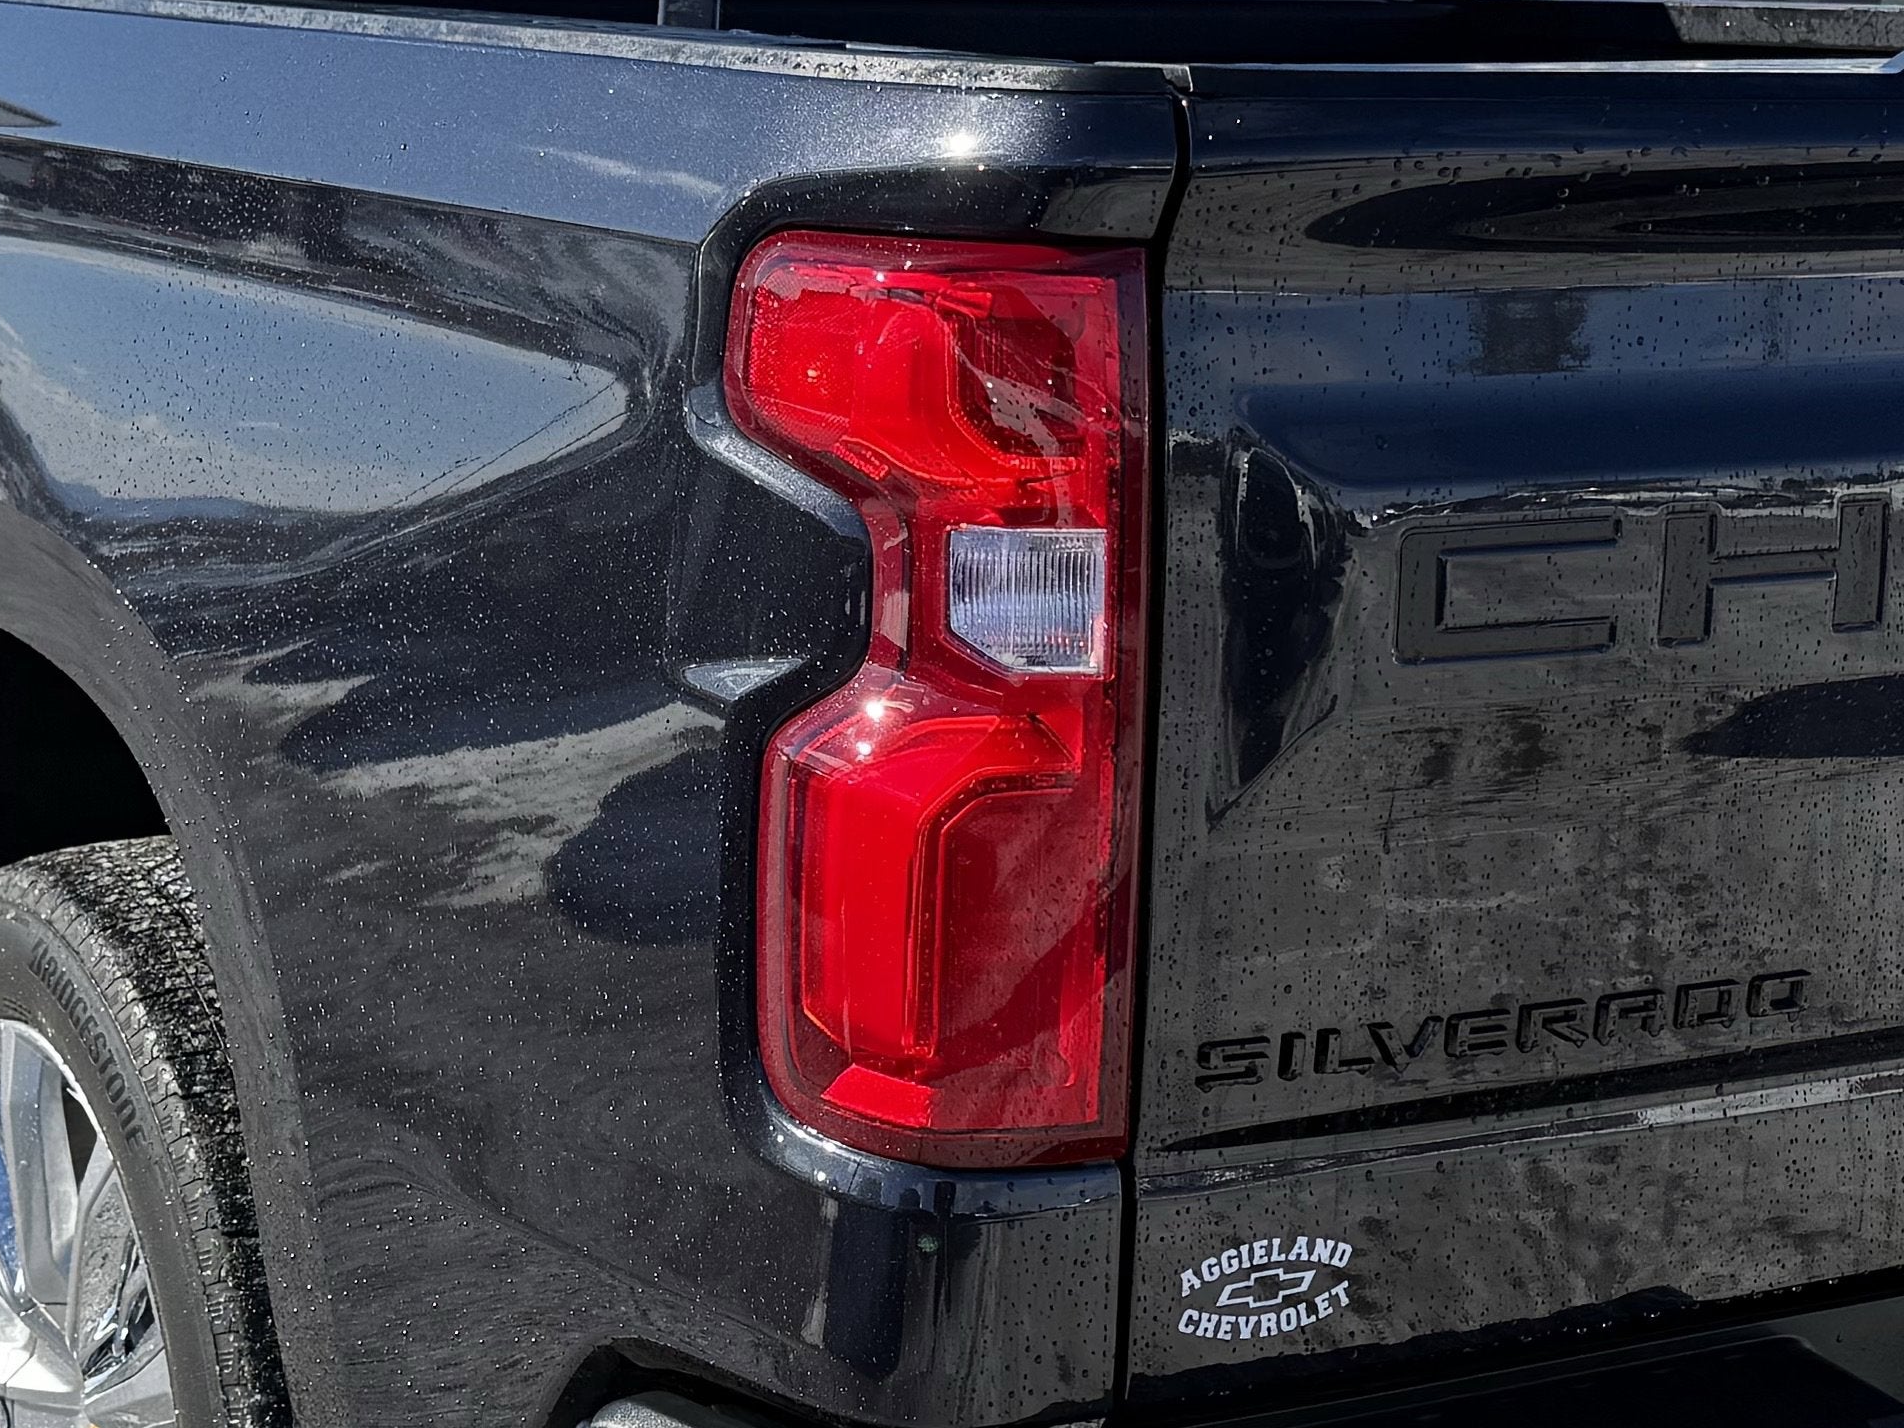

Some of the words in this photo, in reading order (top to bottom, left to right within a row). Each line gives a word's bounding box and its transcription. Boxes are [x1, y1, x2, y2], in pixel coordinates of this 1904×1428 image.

[1195, 968, 1812, 1092] SILVERADO
[1179, 1235, 1354, 1298] AGGIELAND
[1177, 1279, 1351, 1341] CHEVROLET
